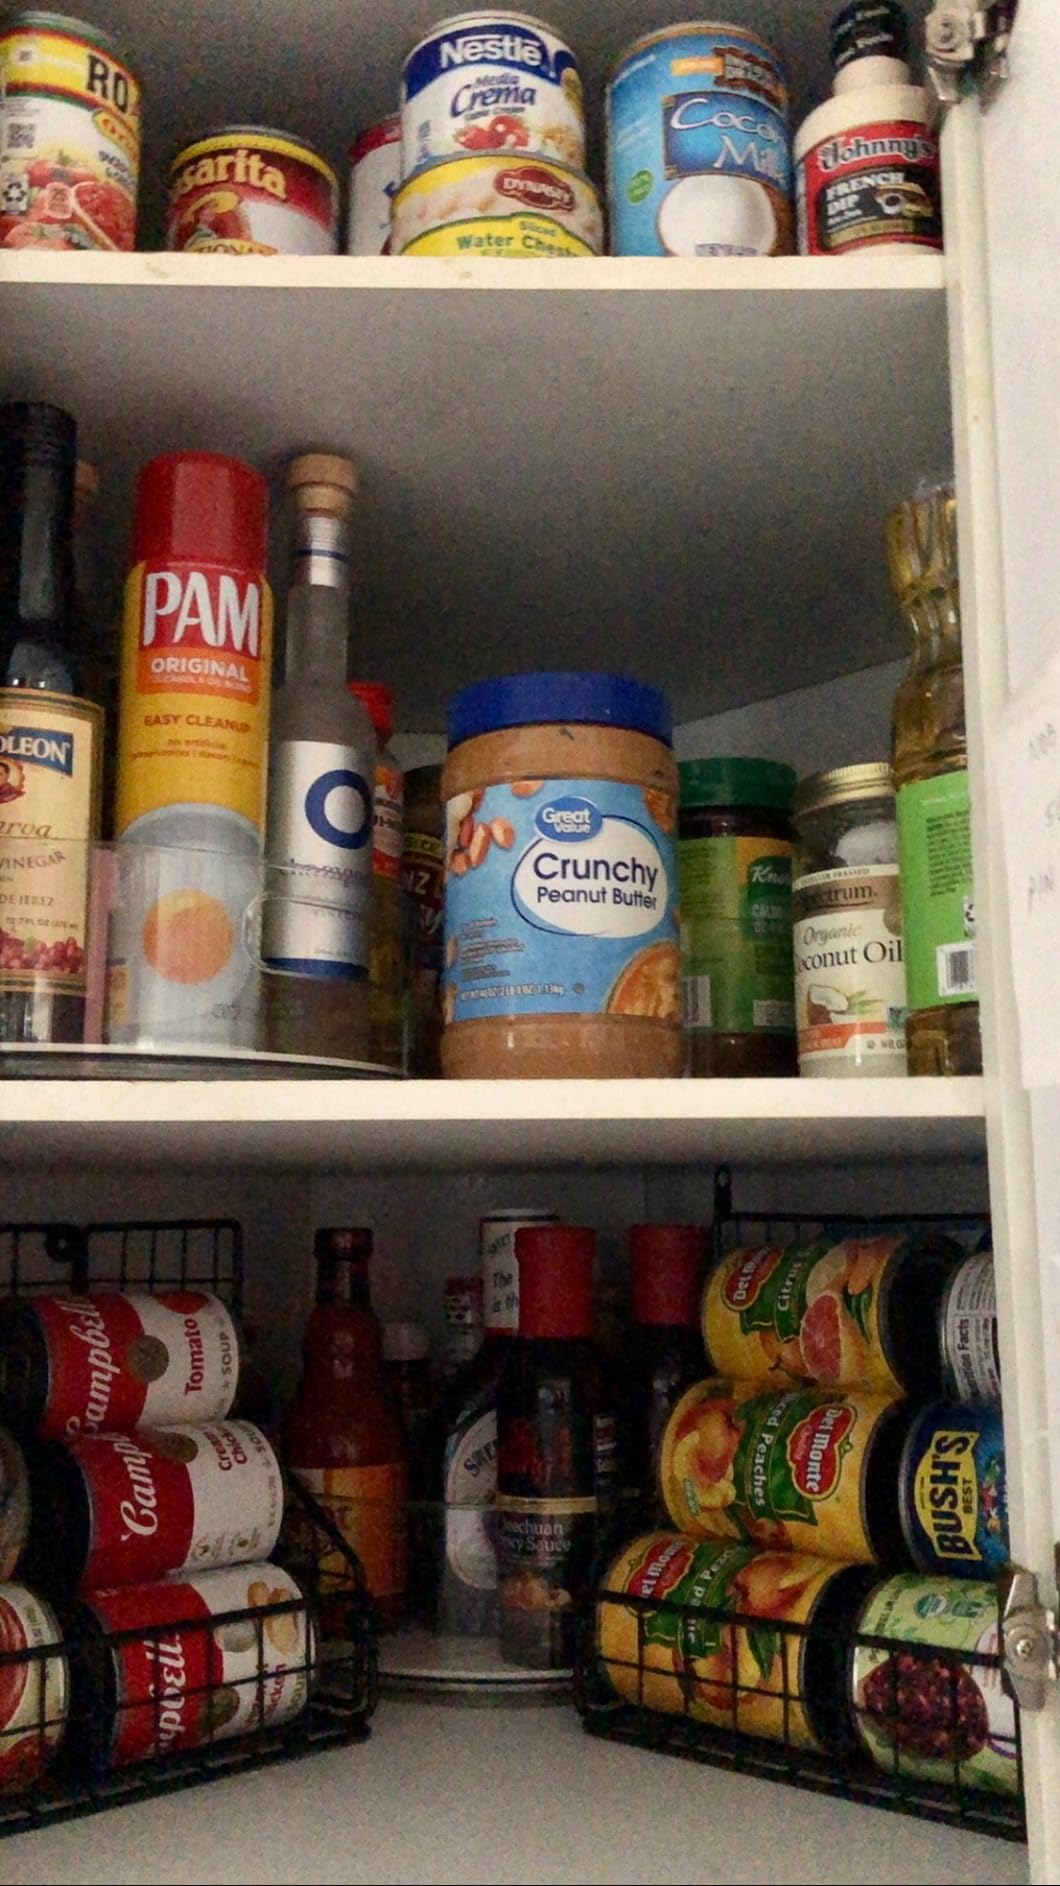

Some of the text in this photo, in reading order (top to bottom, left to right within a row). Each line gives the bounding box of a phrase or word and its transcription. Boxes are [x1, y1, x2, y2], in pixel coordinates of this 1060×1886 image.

[450, 83, 537, 118] Crema
[671, 98, 781, 144] Coco
[817, 136, 932, 171] Johnny's
[826, 171, 904, 200] FRENCH
[827, 194, 860, 215] DIP
[457, 234, 513, 251] Water
[519, 221, 557, 237] Sliced
[143, 571, 261, 657] PAM
[151, 657, 249, 684] ORIGINAL
[144, 713, 252, 735] EASY CLEANUP
[541, 806, 591, 825] Great
[553, 822, 591, 834] Value
[533, 852, 659, 893] Crunchy
[536, 886, 657, 911] Peanut Butter
[803, 923, 863, 946] Organic
[798, 940, 903, 973] oconut Oil
[732, 1274, 752, 1302] Del
[777, 1260, 804, 1312] Citrus
[957, 1317, 970, 1351] Facts
[182, 1317, 204, 1396] Tomato
[218, 1330, 233, 1377] SOUP
[804, 1407, 844, 1493] Del Monte
[753, 1432, 775, 1507] Peaches
[929, 1435, 974, 1554] BUSH'S
[961, 1477, 974, 1515] BEST
[503, 1518, 565, 1537] zechuan
[526, 1535, 572, 1553] Sauce
[638, 1578, 658, 1599] el
